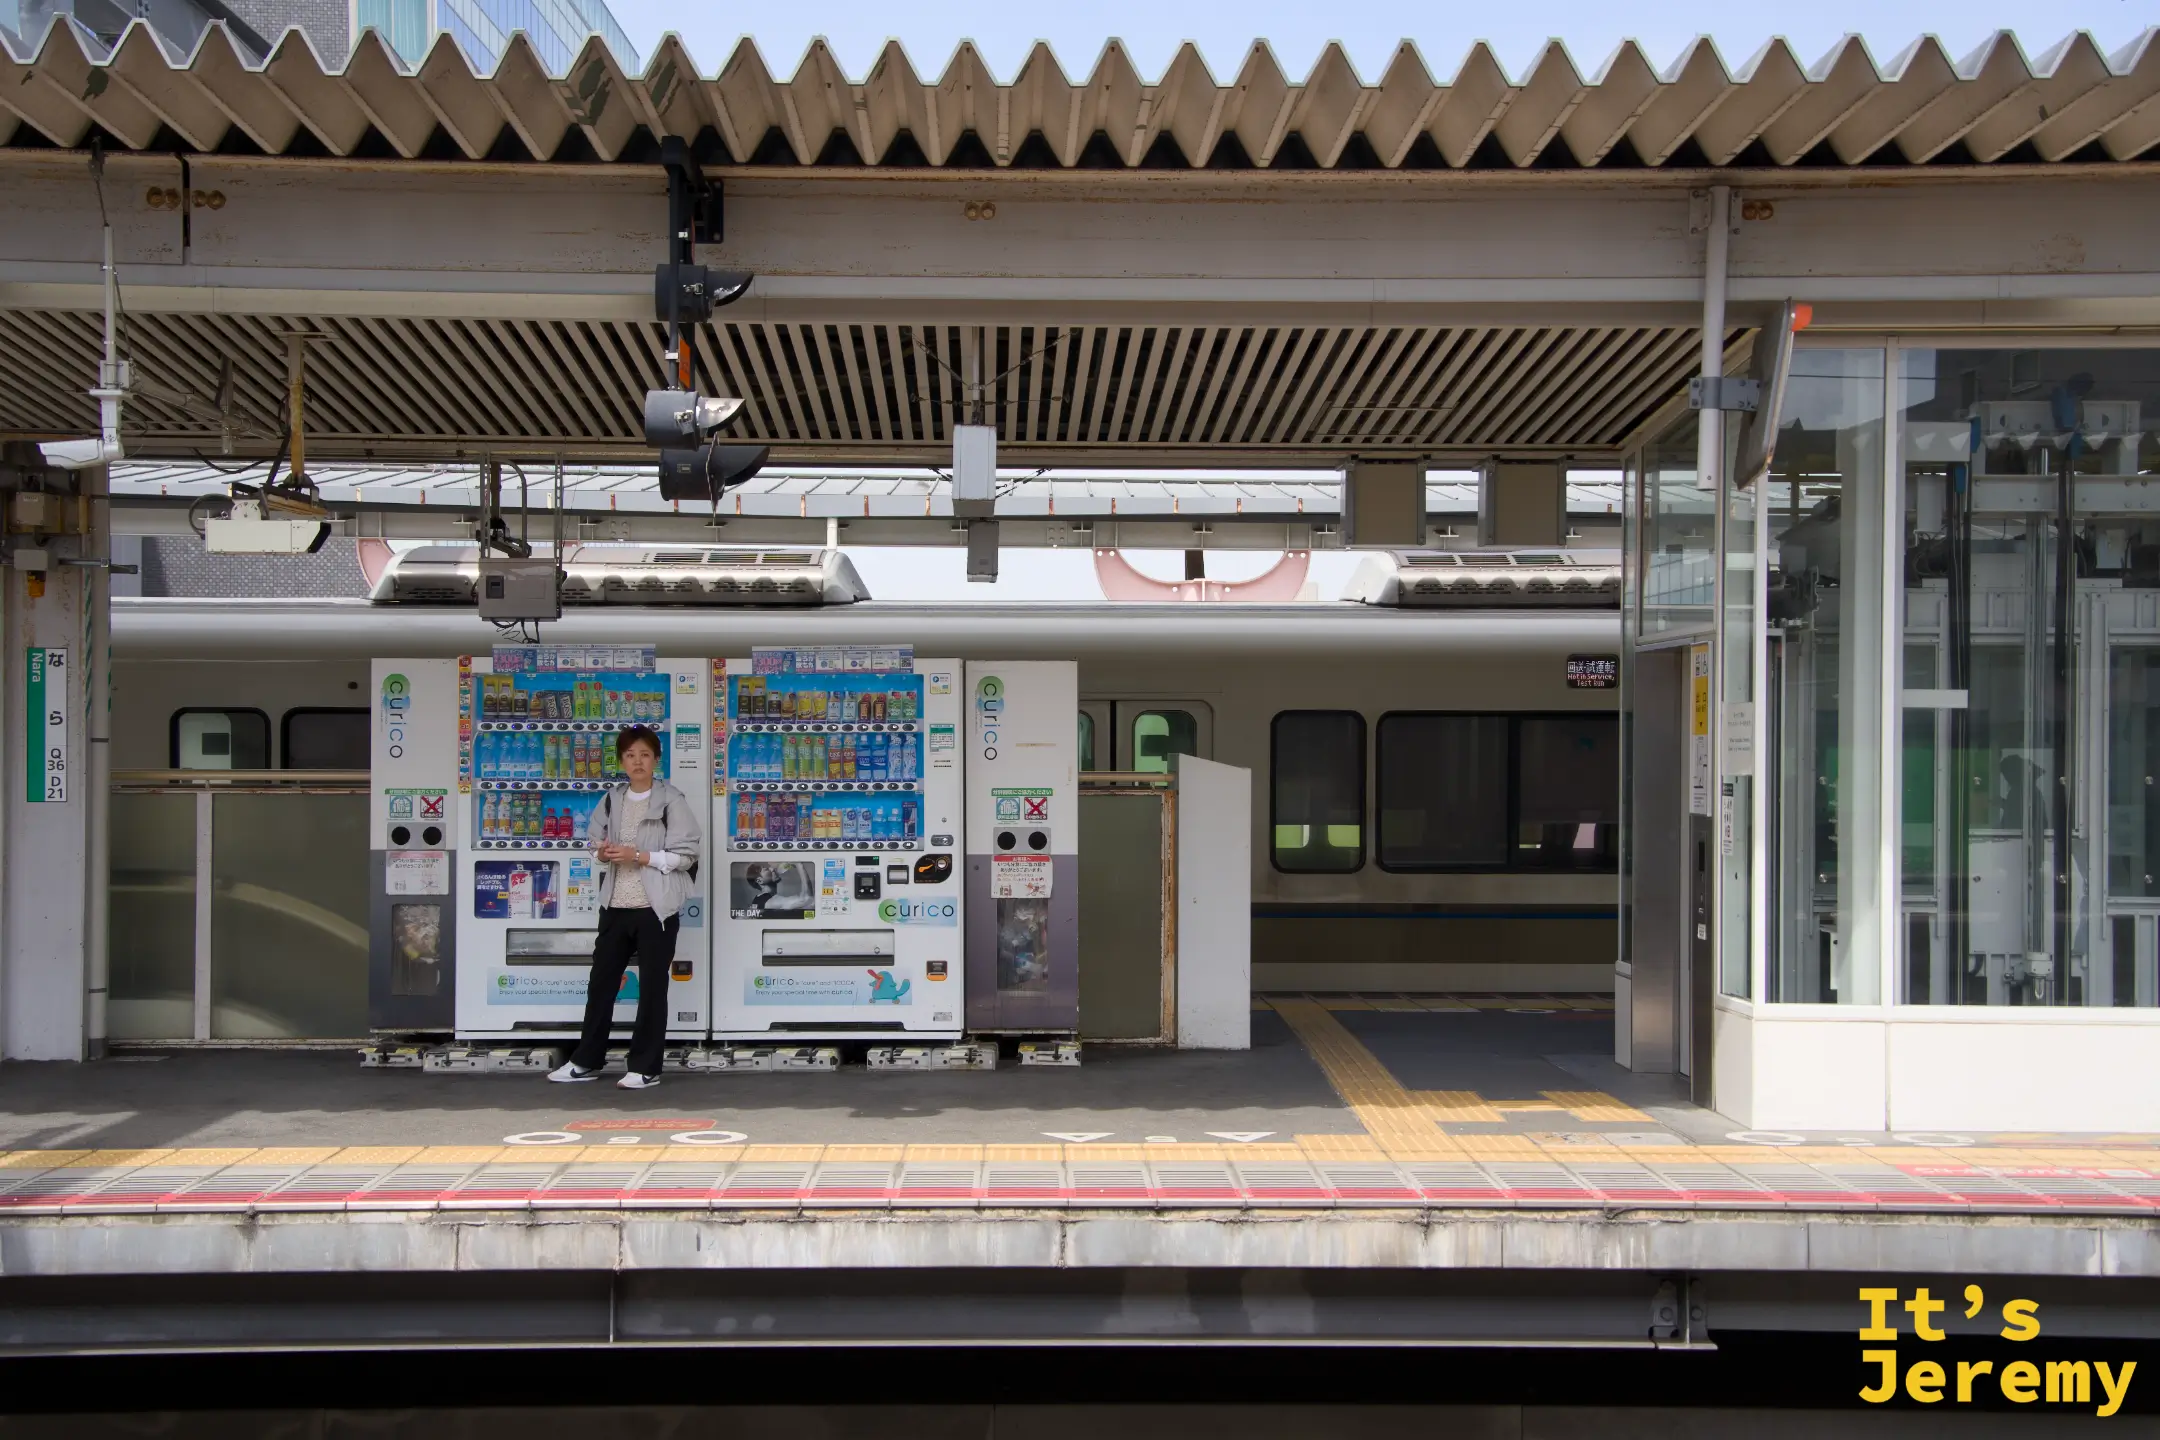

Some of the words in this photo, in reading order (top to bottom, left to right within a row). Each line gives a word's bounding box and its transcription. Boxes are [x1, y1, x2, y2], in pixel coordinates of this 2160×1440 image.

[32, 653, 43, 683] Nara
[1576, 679, 1592, 687] Test
[48, 652, 64, 726] なら
[389, 680, 406, 759] curico
[983, 682, 1001, 761] curico
[51, 748, 61, 759] Q
[48, 760, 65, 771] 36
[51, 776, 61, 787] D
[47, 788, 63, 799] 21
[731, 909, 745, 917] THE
[746, 909, 763, 917] DAY.
[884, 901, 955, 917] curico
[500, 976, 539, 986] curico
[757, 978, 794, 986] curico
